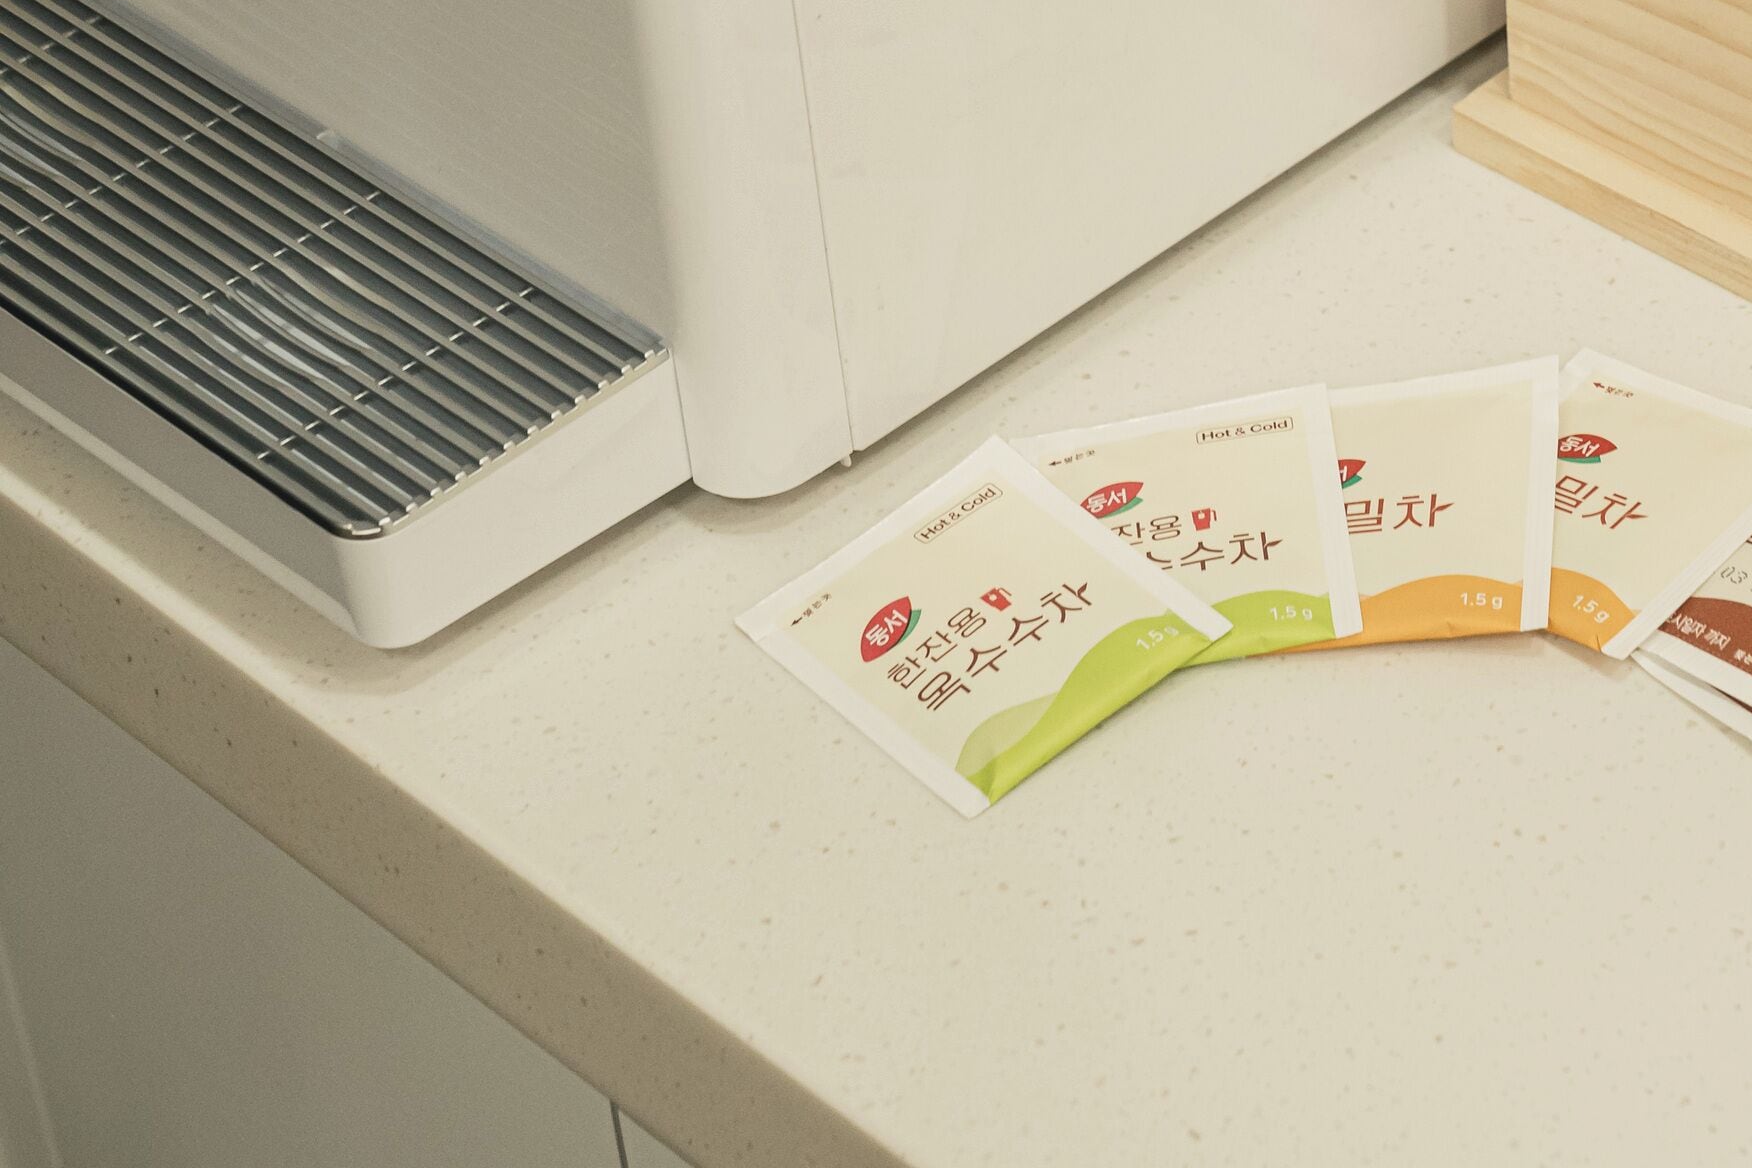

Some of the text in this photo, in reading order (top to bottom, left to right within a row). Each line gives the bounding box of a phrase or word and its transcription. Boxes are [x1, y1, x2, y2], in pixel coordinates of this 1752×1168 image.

[1201, 418, 1289, 442] Hot & Cold
[1560, 434, 1600, 458] 동서
[1087, 487, 1128, 513] 동서
[920, 487, 997, 540] Hot & Cold
[1270, 605, 1313, 622] 1.5 g
[1460, 592, 1503, 610] 1.5 g
[1572, 594, 1611, 624] 1.5 g
[865, 609, 909, 648] 동서
[1136, 627, 1164, 652] 1.5
[887, 607, 987, 690] 한잔용
[917, 582, 1093, 712] 옥수수차
